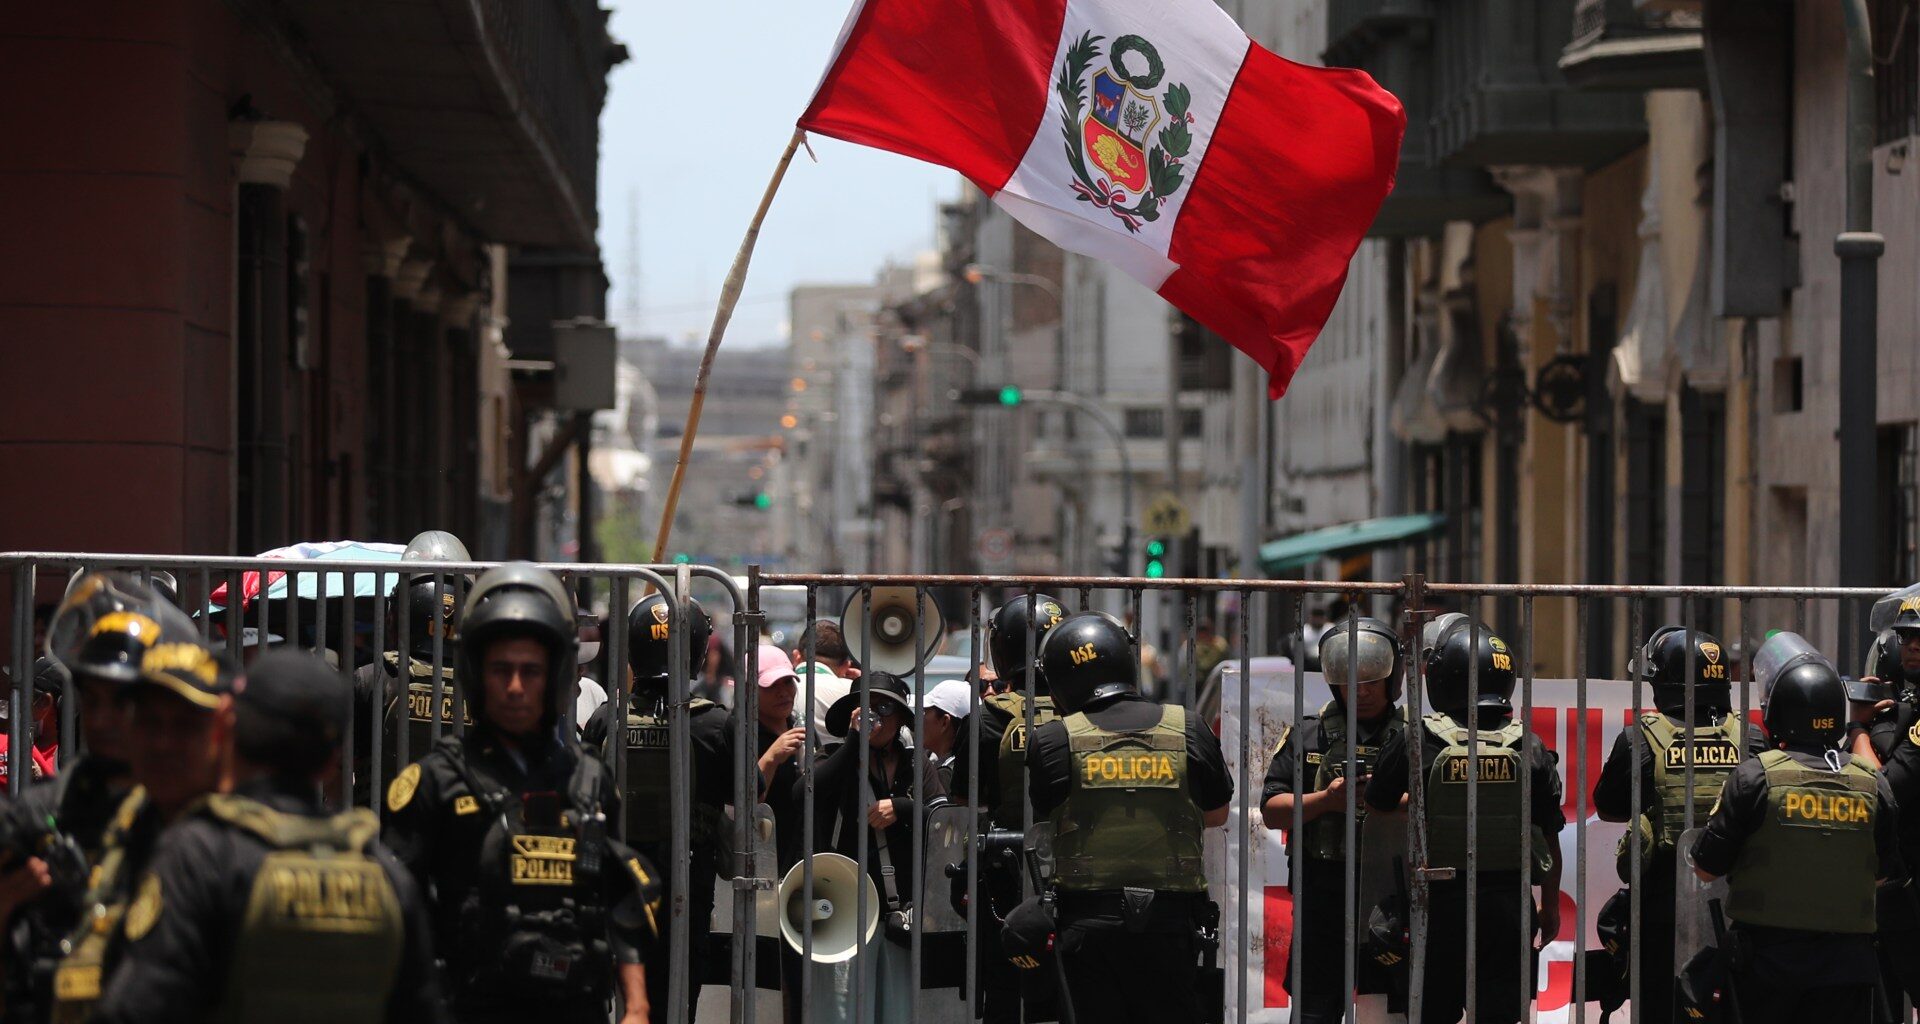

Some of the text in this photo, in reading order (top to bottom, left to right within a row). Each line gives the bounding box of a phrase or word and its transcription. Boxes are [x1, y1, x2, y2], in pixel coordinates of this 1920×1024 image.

[651, 623, 669, 641] US
[1071, 643, 1098, 665] USE
[1492, 653, 1512, 671] USE
[408, 694, 469, 720] POLCA
[1813, 719, 1834, 729] USE
[1087, 756, 1174, 780] POLICIA
[1451, 758, 1510, 781] POICIA
[1786, 793, 1868, 823] POLICIA
[515, 858, 573, 879] POLICI
